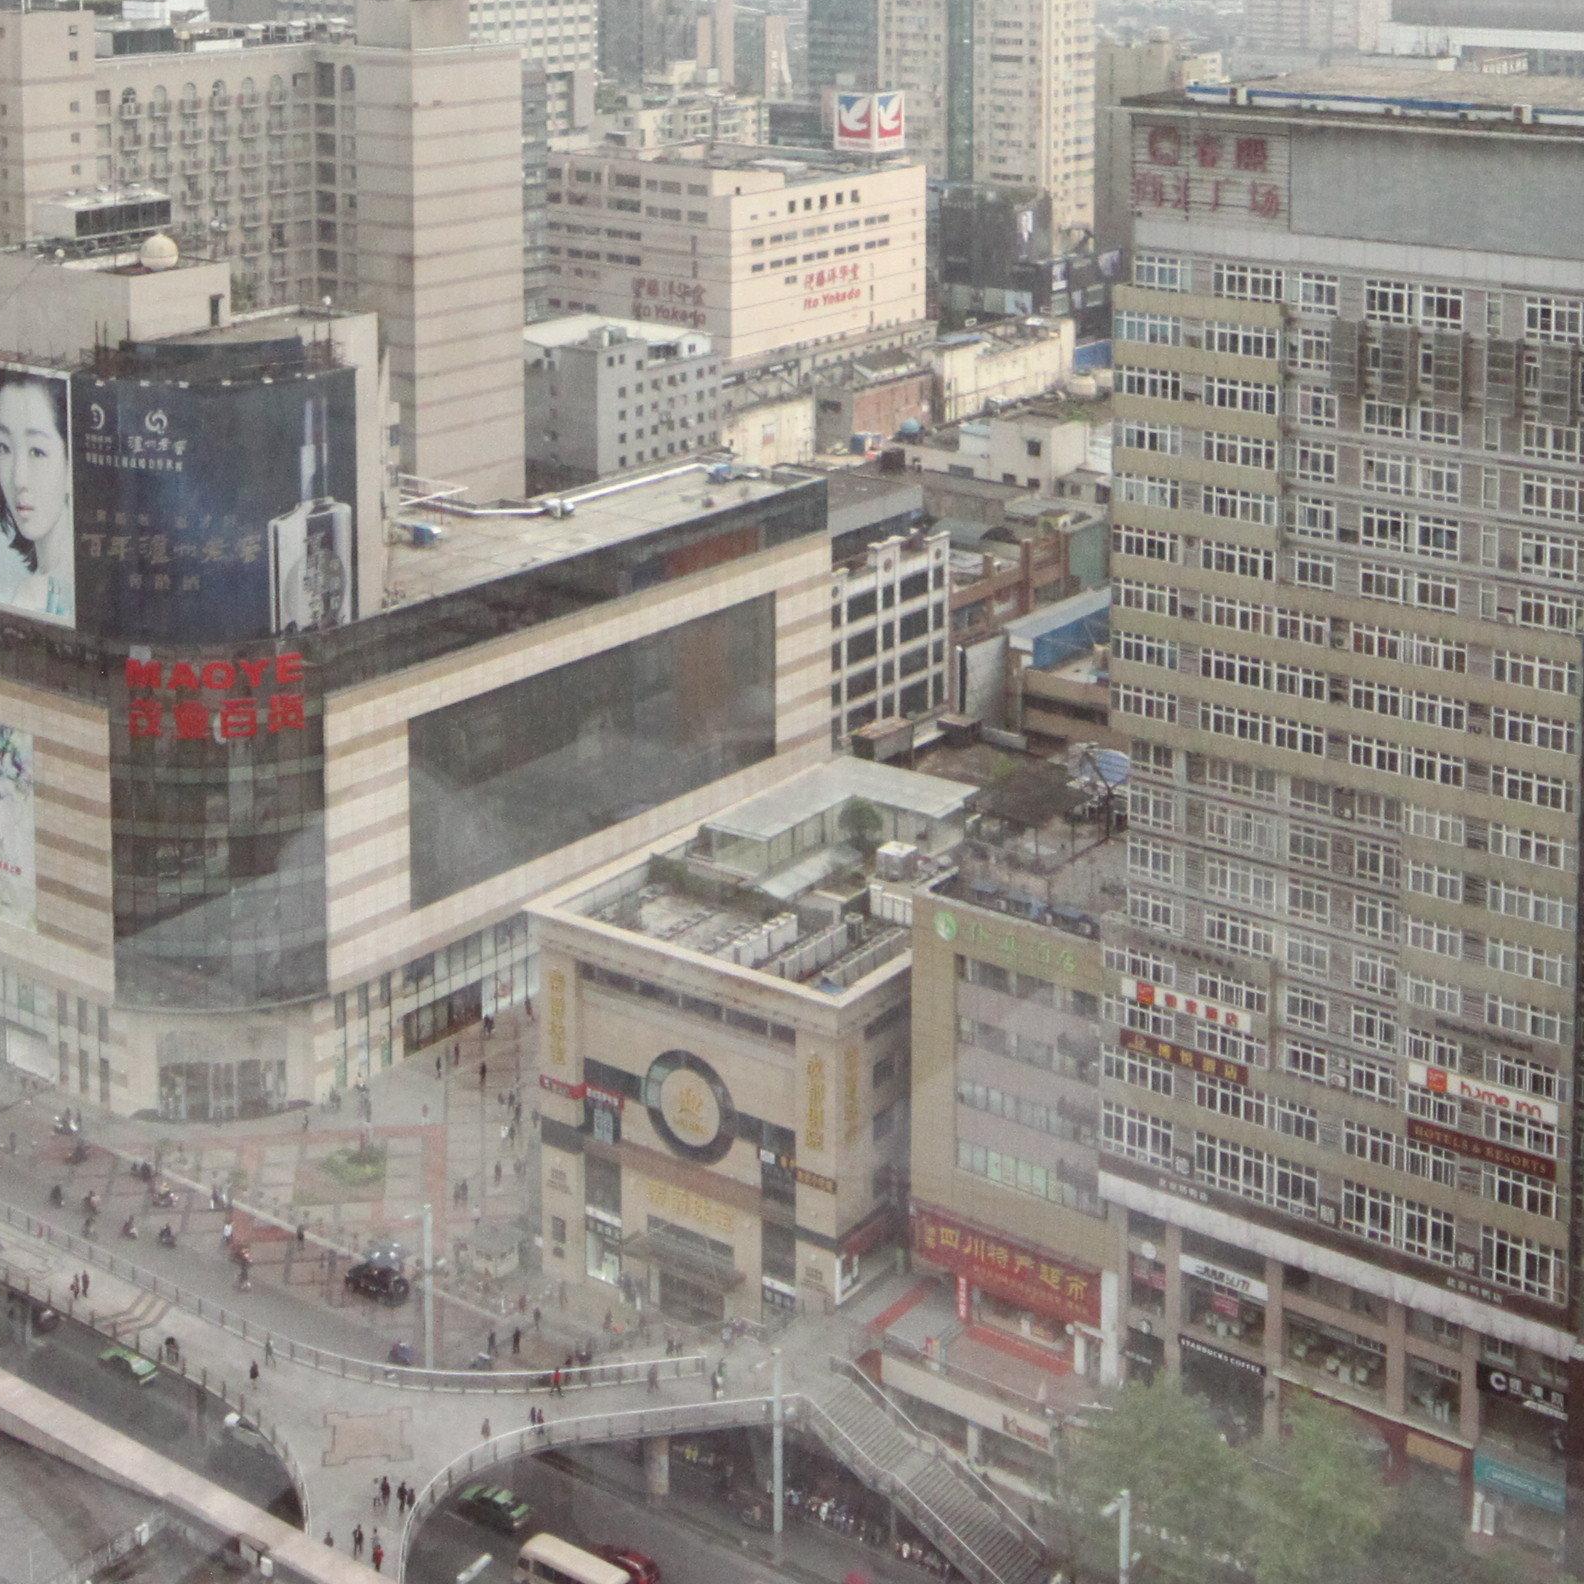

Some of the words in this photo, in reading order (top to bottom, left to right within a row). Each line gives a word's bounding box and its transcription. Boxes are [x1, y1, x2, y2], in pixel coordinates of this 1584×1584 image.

[125, 652, 306, 691] MAOYE
[1460, 1081, 1510, 1108] home
[1516, 1100, 1542, 1118] inn
[1415, 1125, 1469, 1149] HOTELS
[1486, 1147, 1546, 1174] RESORTS
[1180, 1338, 1229, 1362] STARBUCKS
[1230, 1357, 1261, 1374] COFFEE
